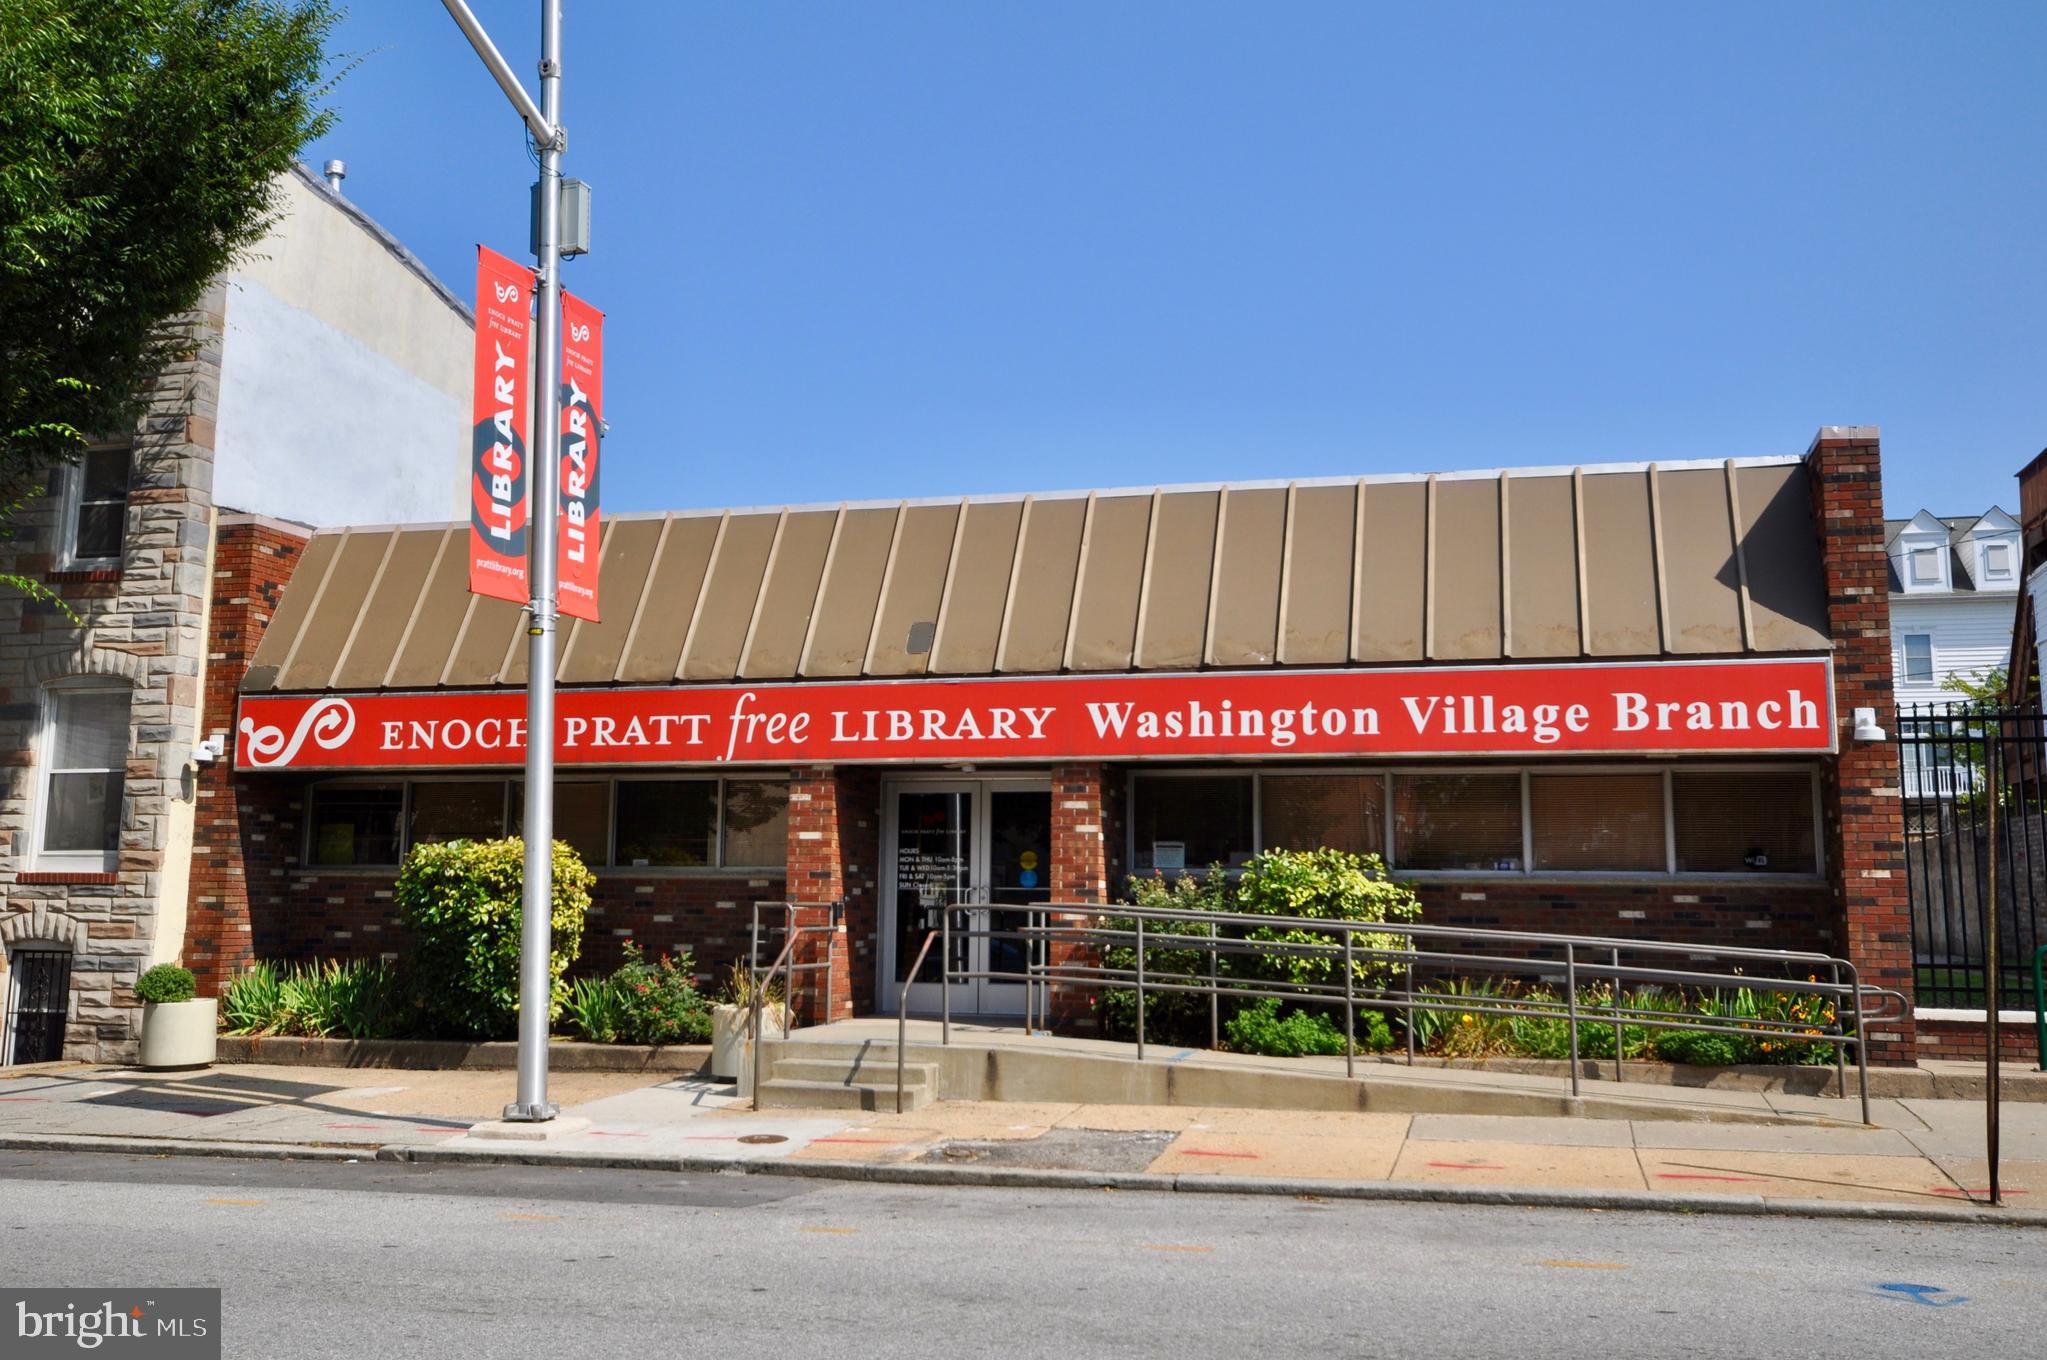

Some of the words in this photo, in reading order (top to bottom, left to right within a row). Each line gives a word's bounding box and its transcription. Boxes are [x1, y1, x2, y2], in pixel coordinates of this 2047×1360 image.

[491, 339, 515, 541] LIBRARY
[567, 376, 587, 563] LIBRARY
[476, 559, 525, 580] prattlibrary.org
[562, 715, 711, 747] PRATT
[716, 692, 811, 762] free
[831, 707, 1057, 742] LIBRARY
[1085, 700, 1381, 747] Washington
[1400, 695, 1590, 744] Village
[1611, 689, 1820, 731] Branch
